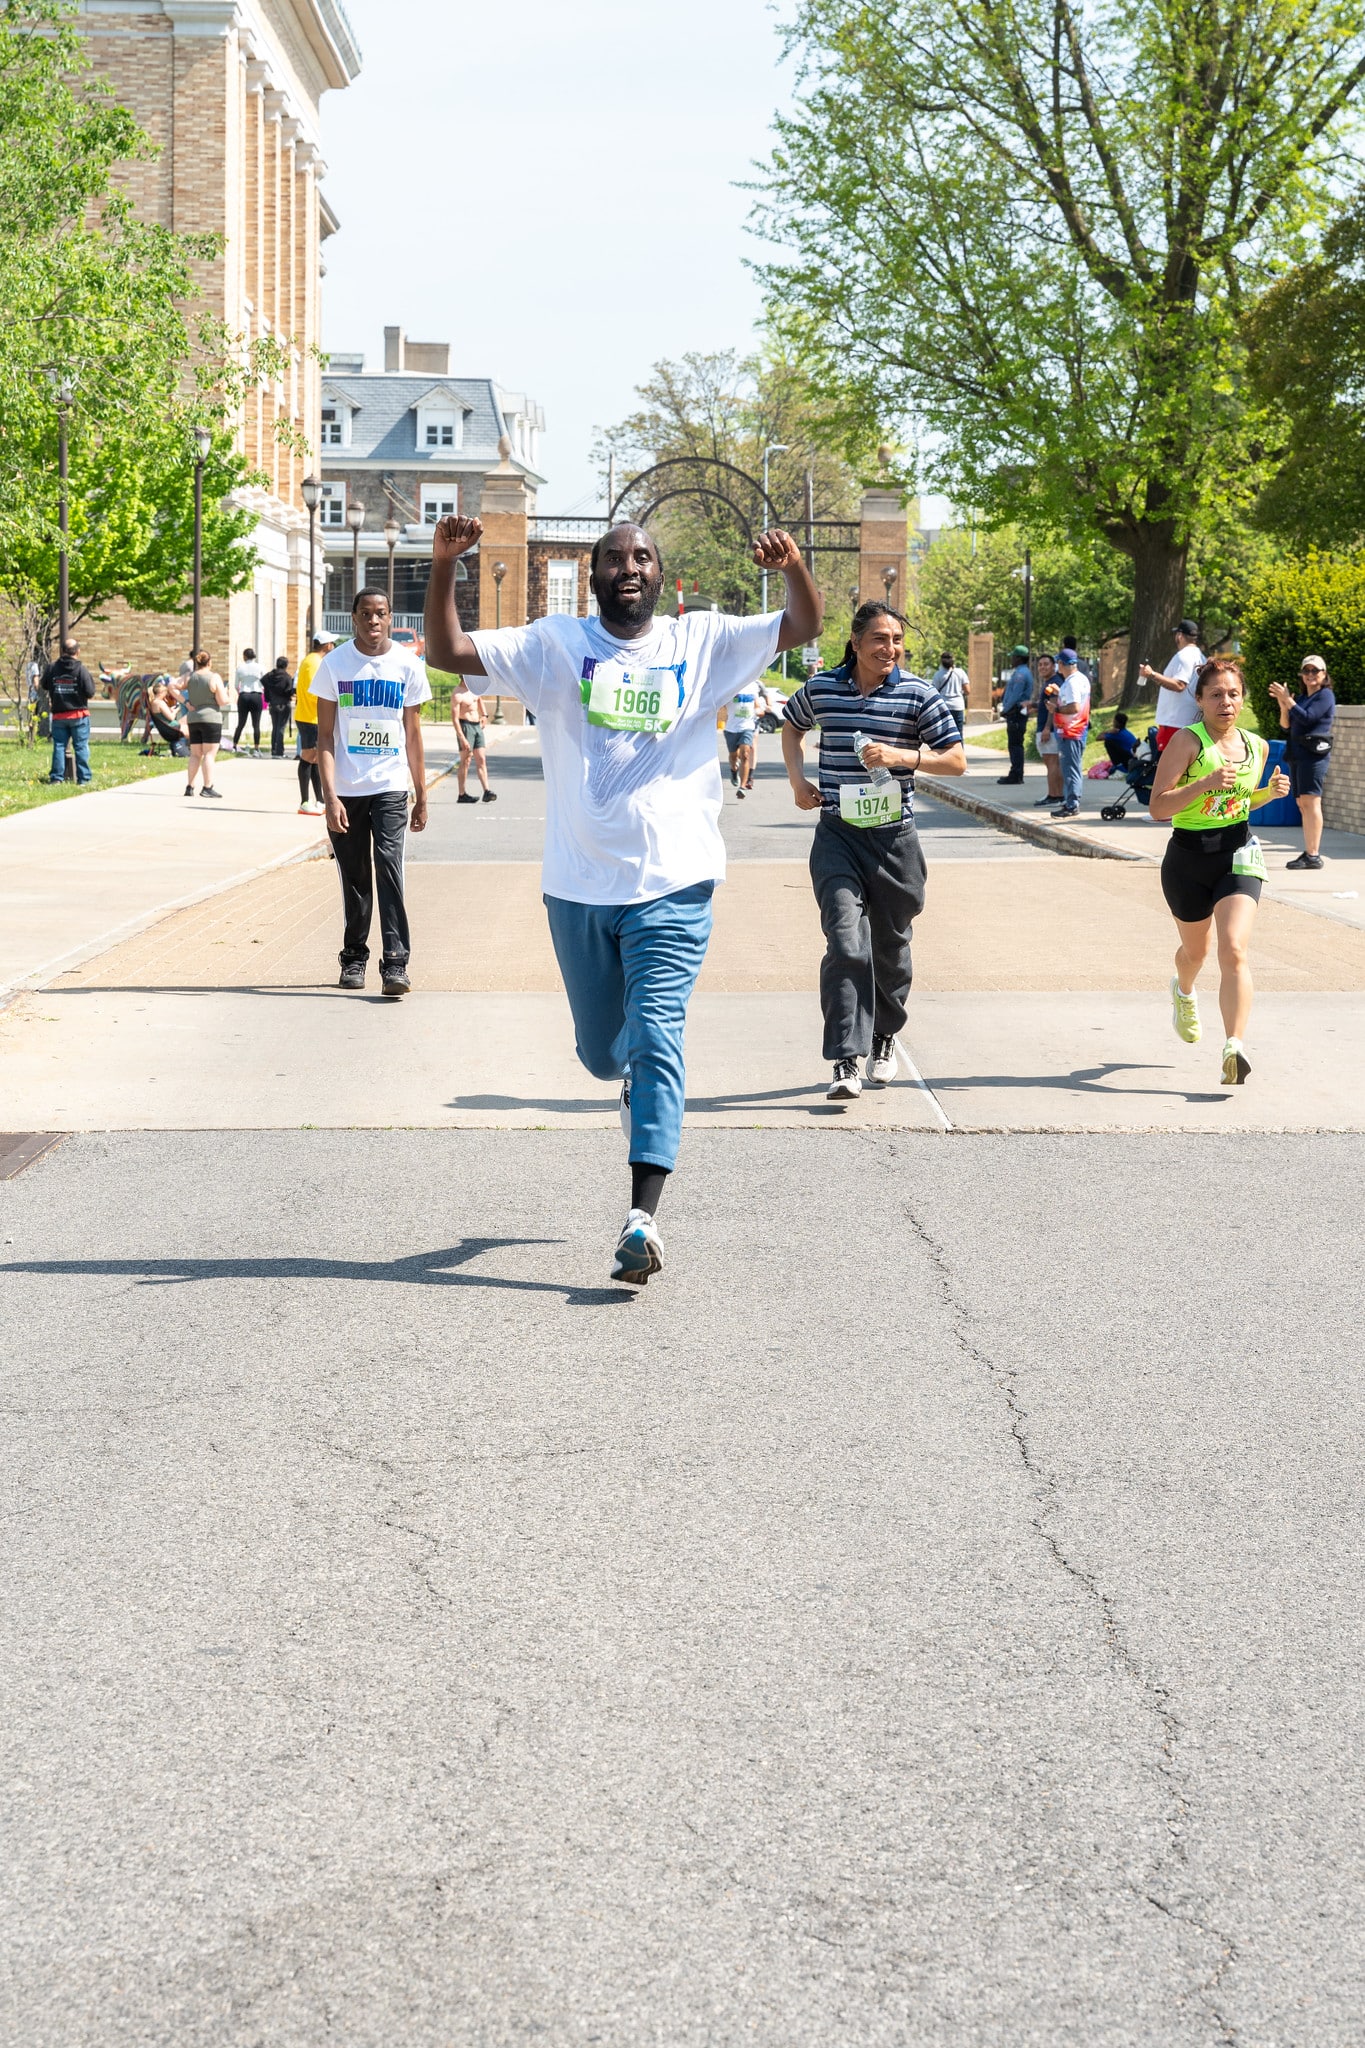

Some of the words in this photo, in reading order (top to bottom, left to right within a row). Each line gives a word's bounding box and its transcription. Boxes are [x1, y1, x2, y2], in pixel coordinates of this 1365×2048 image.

[354, 679, 405, 709] BRONX
[613, 688, 661, 715] 1966
[643, 718, 664, 732] 5K
[359, 731, 390, 747] 2204
[855, 796, 890, 816] 1974
[880, 813, 893, 824] 5K
